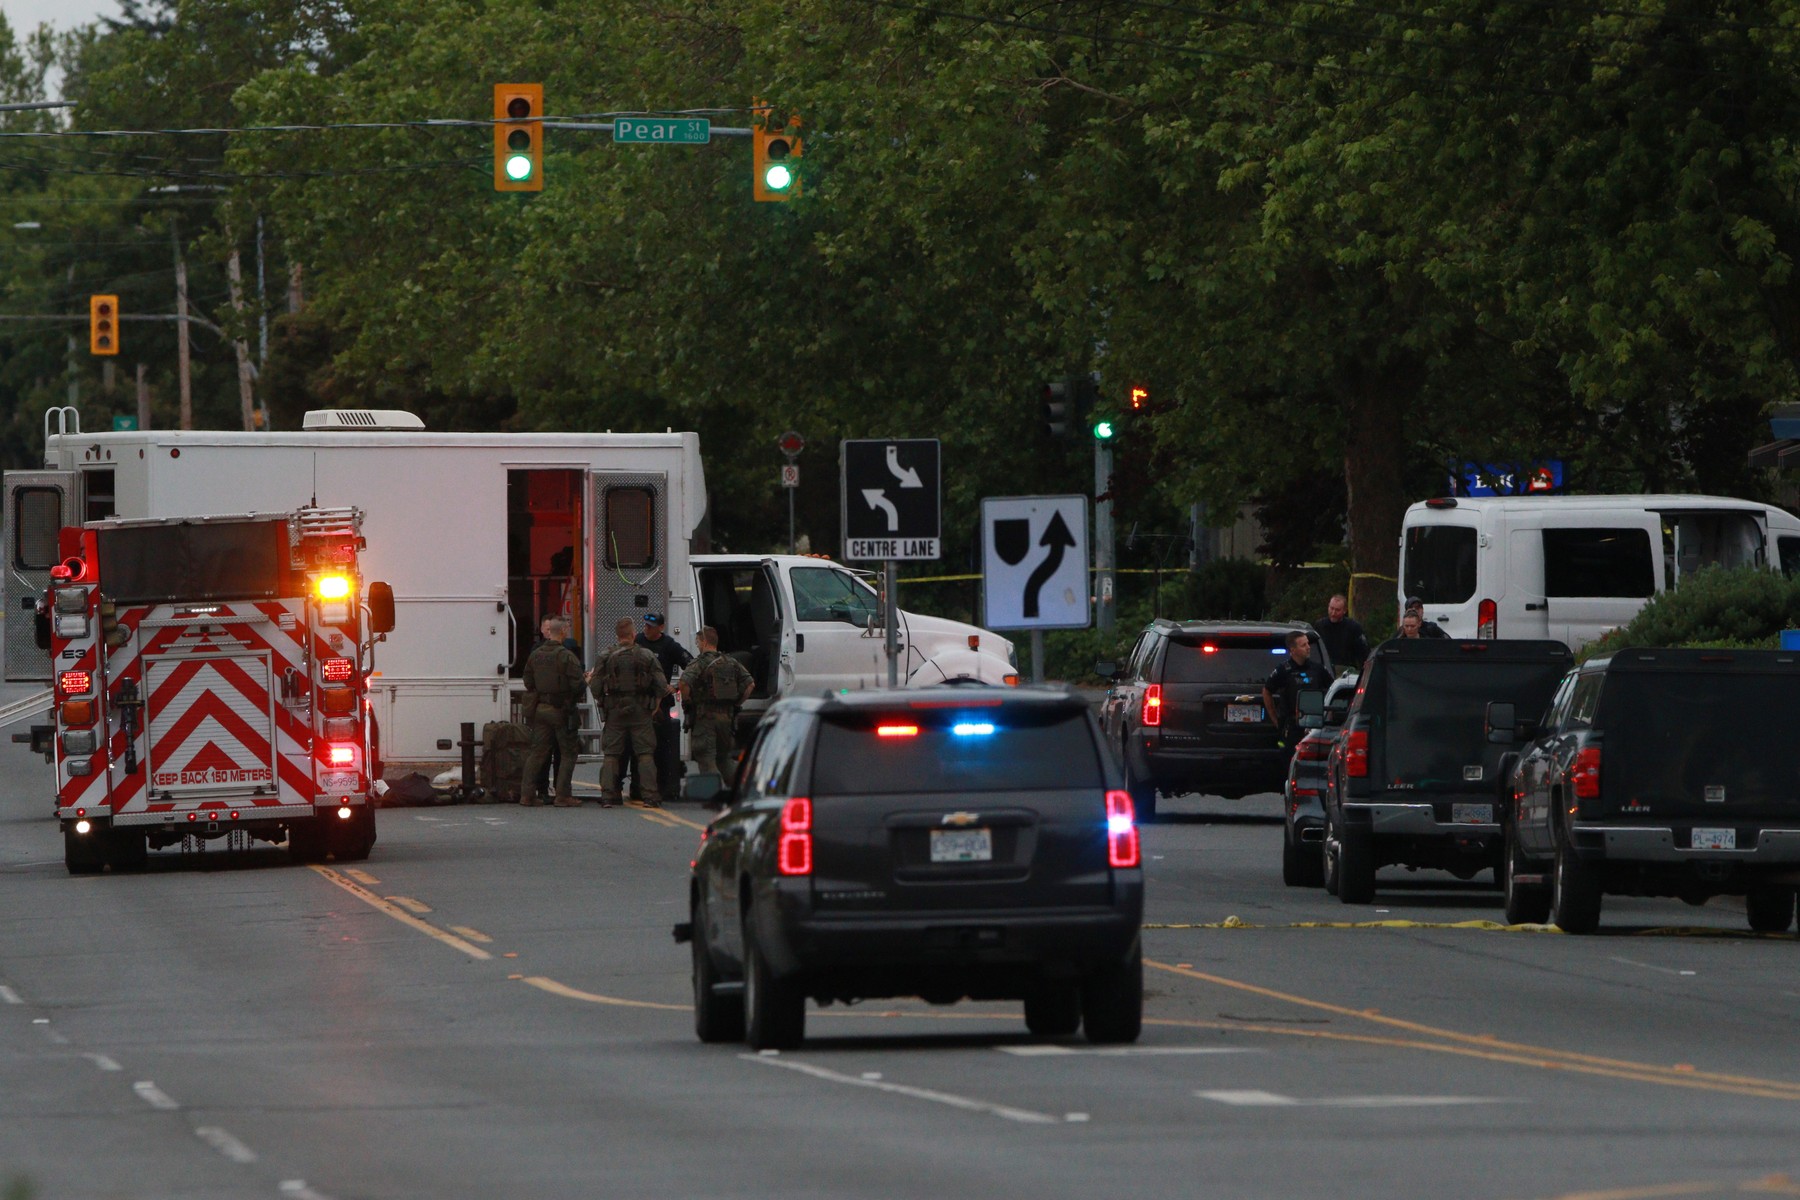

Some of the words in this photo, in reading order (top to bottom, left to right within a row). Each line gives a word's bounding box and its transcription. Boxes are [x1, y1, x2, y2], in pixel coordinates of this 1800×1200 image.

[619, 122, 677, 139] Pear
[688, 121, 700, 131] St
[852, 541, 897, 557] CENTRE
[903, 541, 934, 556] LANE
[62, 649, 87, 659] E3
[151, 773, 178, 786] KEEP
[180, 771, 208, 785] BACK
[211, 770, 228, 783] 150
[230, 768, 273, 782] METERS
